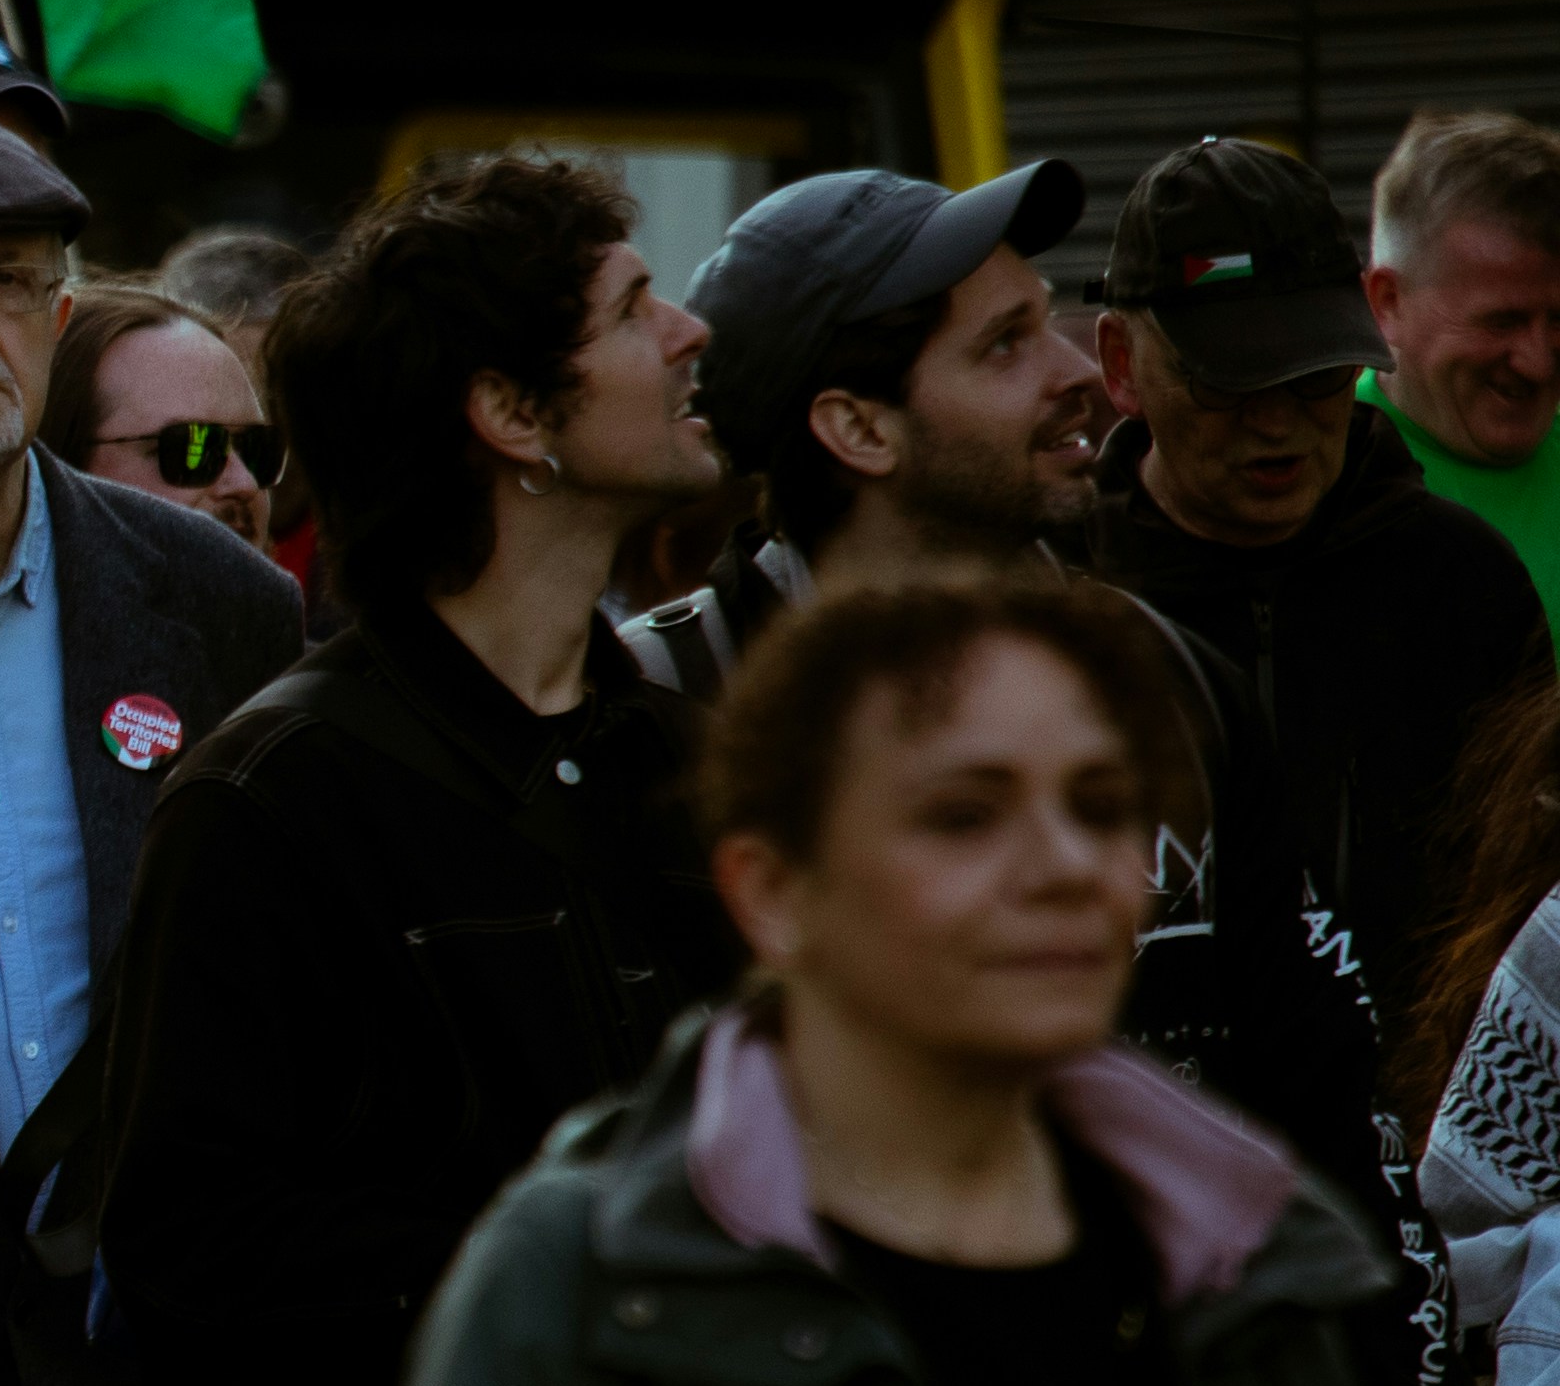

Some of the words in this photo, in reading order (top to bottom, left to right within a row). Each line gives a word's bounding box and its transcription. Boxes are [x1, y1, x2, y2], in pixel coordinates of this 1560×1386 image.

[110, 714, 178, 750] Territories
[114, 702, 181, 735] Occupied
[128, 736, 152, 755] Bill
